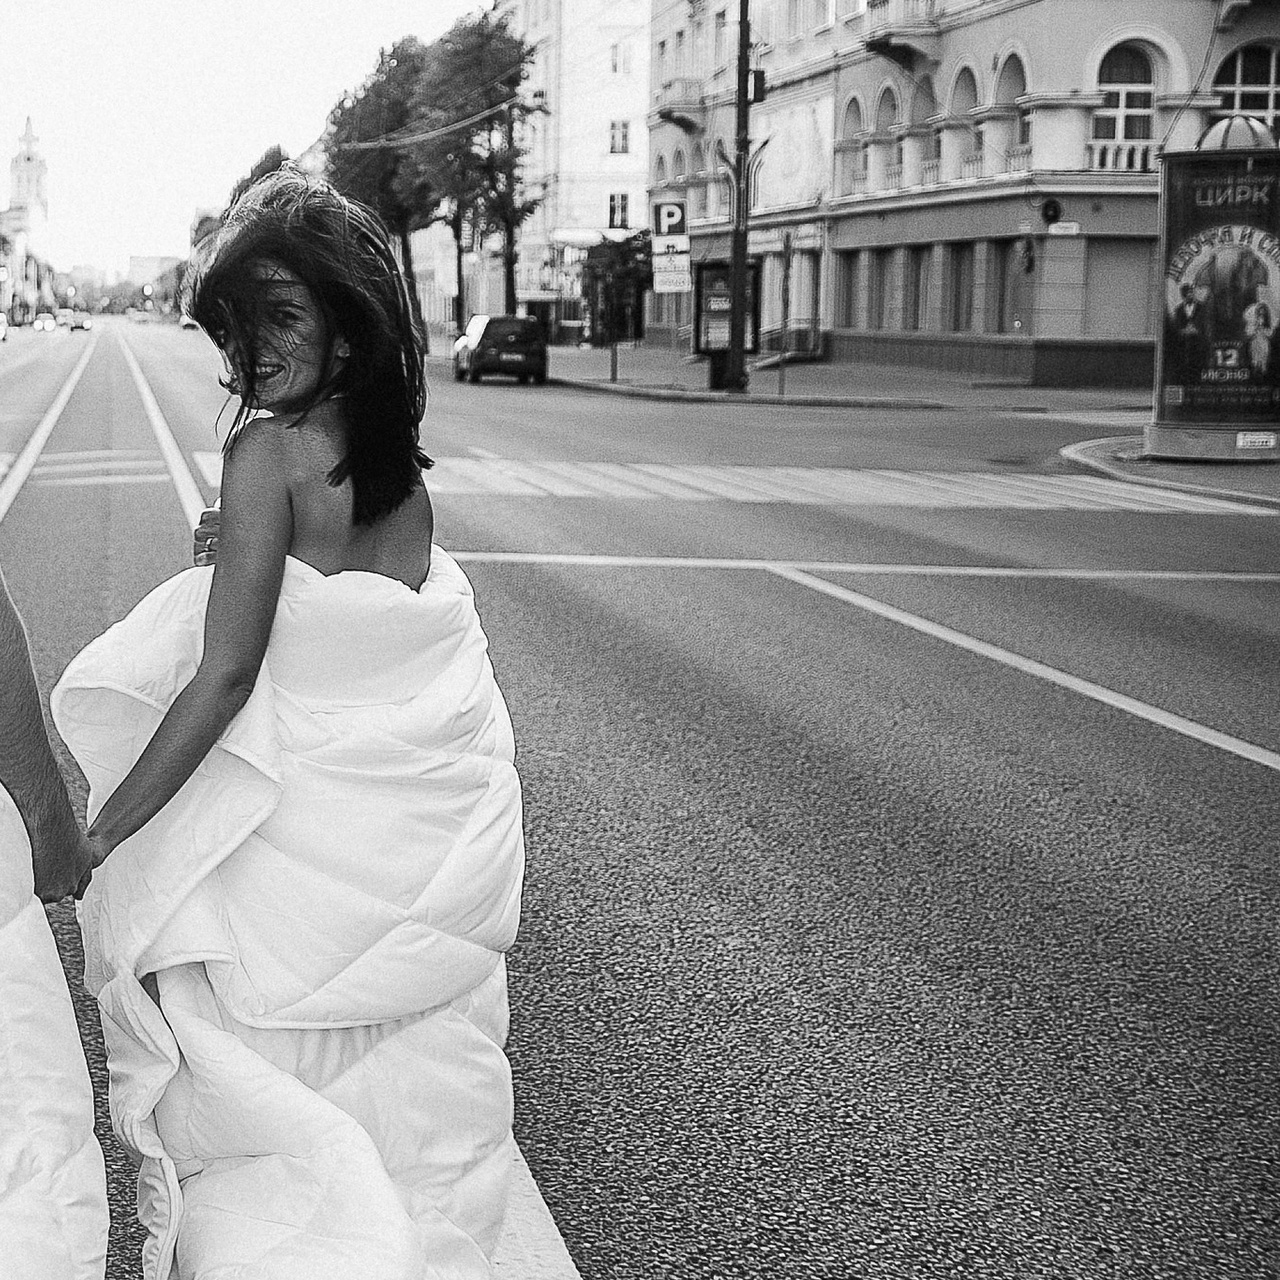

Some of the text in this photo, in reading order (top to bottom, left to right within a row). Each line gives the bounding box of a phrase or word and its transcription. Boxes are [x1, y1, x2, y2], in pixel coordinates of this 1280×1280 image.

[1195, 185, 1270, 206] ЦИРК
[660, 204, 682, 234] P
[1239, 225, 1253, 246] И
[1216, 349, 1239, 367] 12
